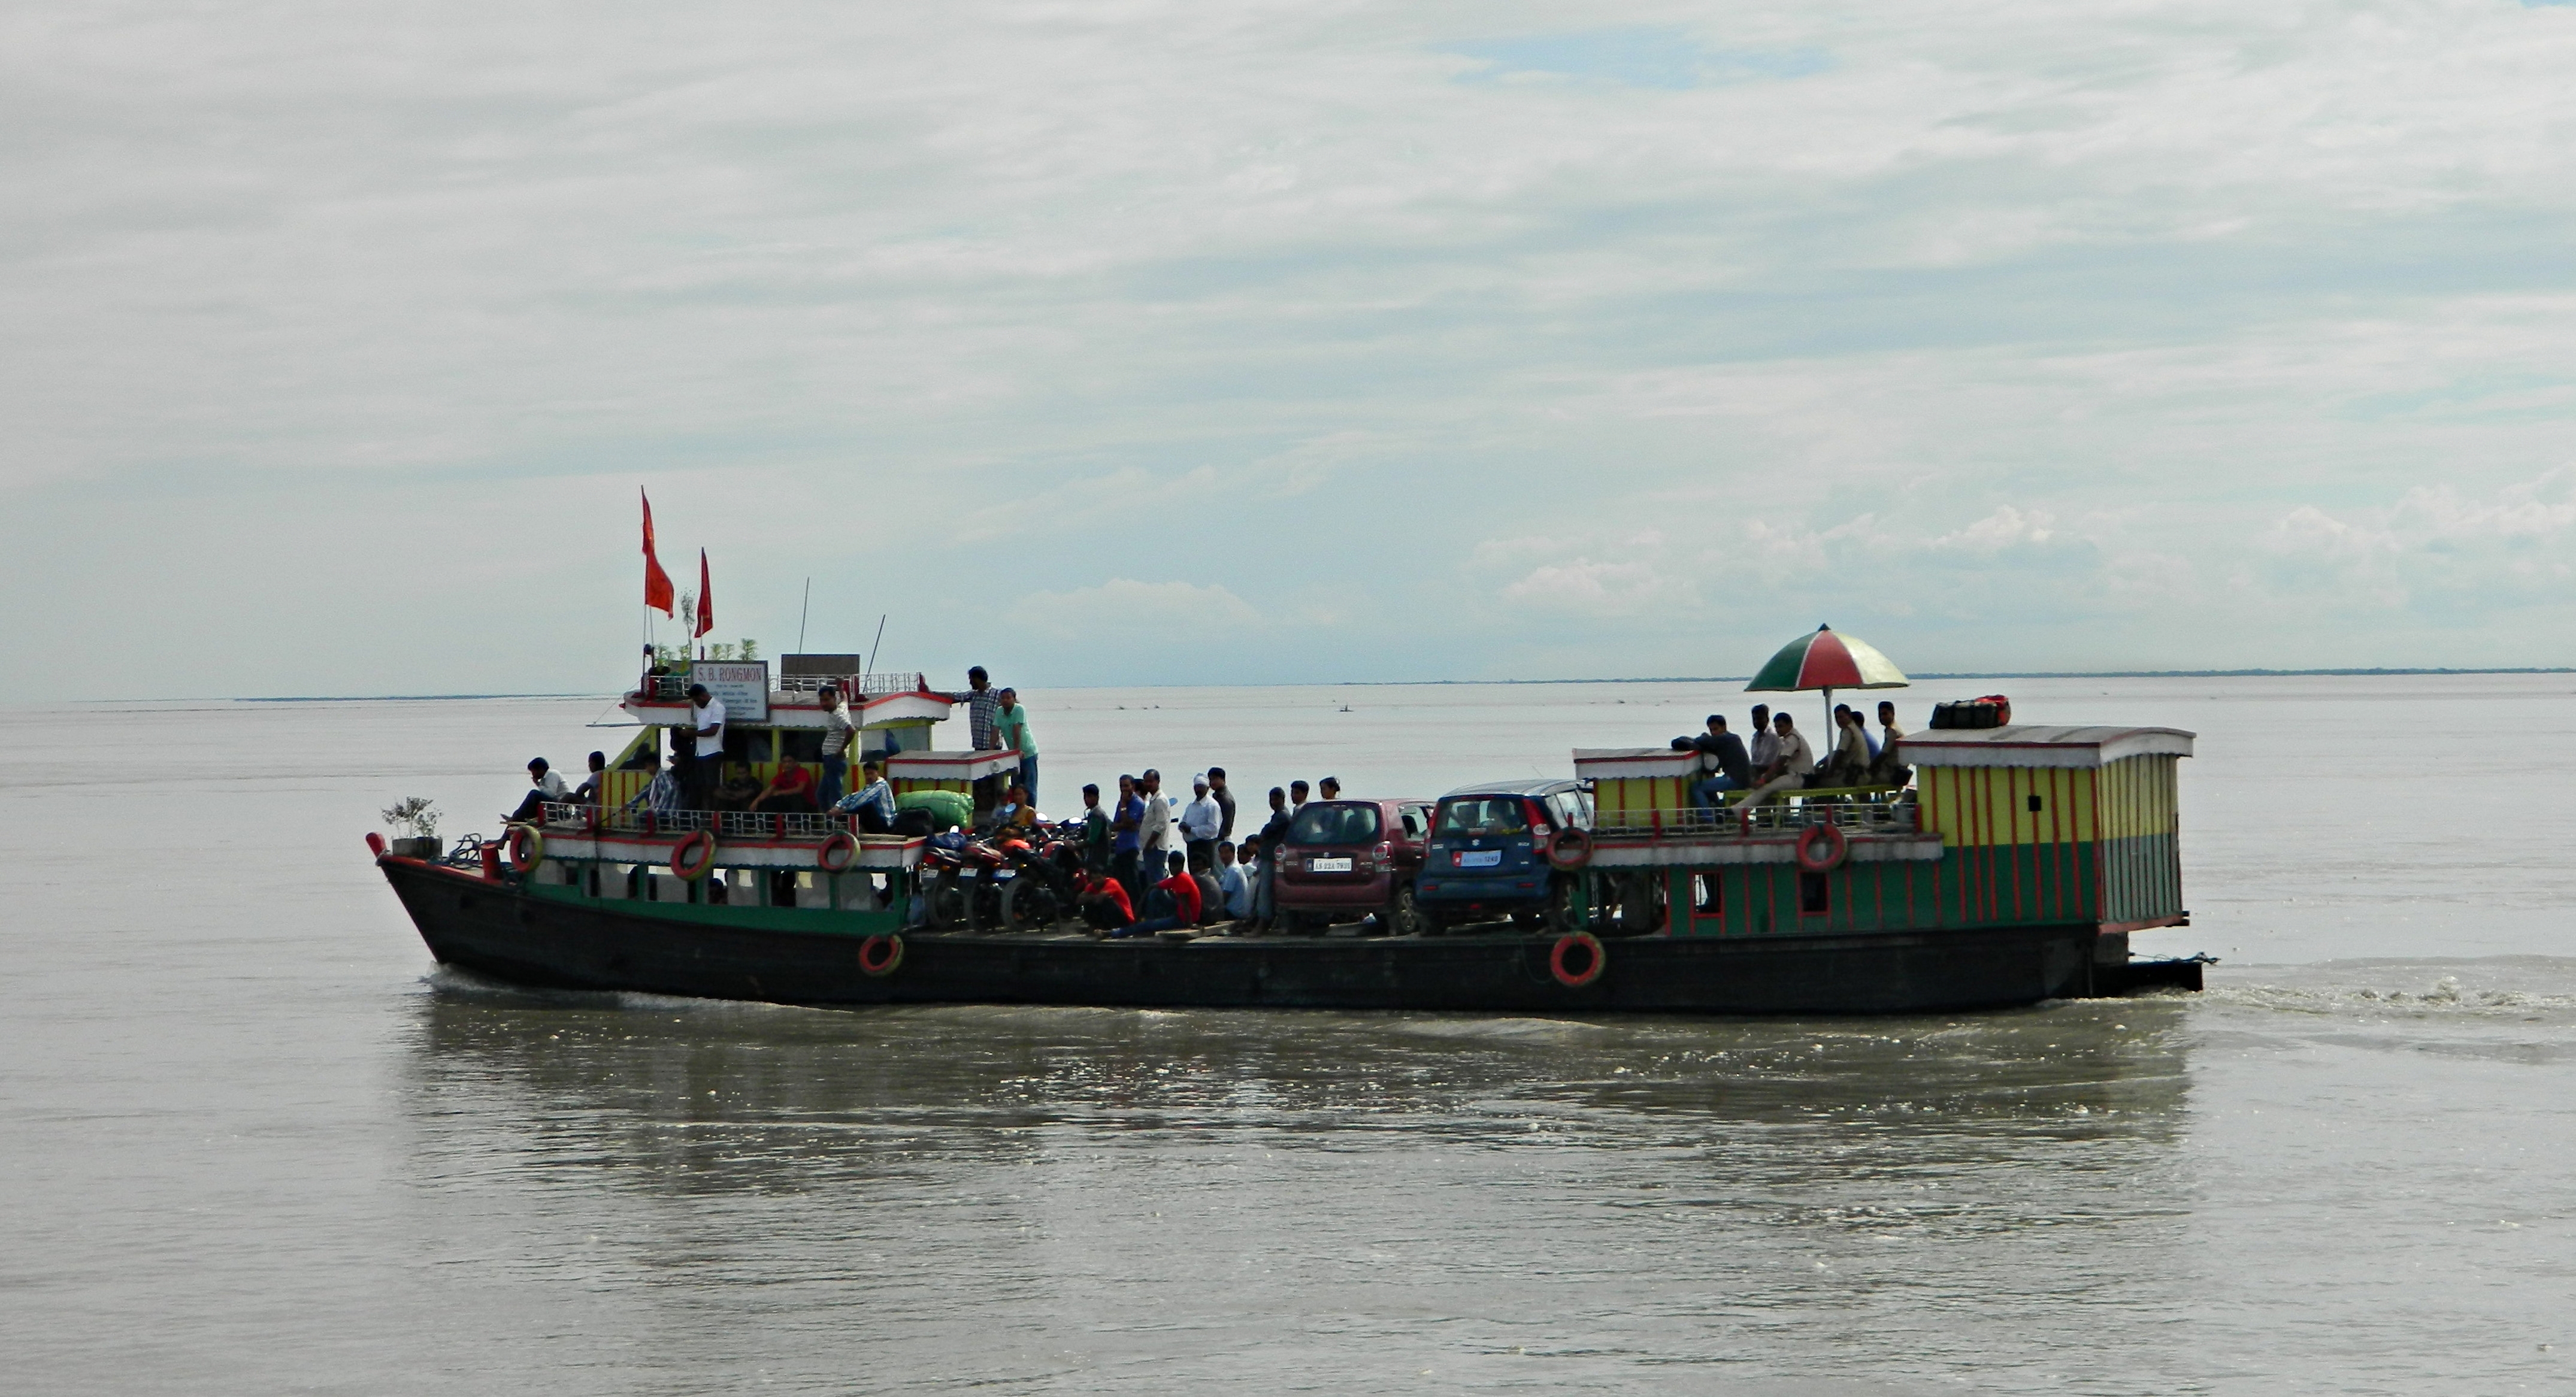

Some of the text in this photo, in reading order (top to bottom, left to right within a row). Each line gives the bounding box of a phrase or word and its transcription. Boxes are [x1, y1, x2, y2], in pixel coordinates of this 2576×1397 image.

[698, 667, 762, 681] S. B. RONGMON
